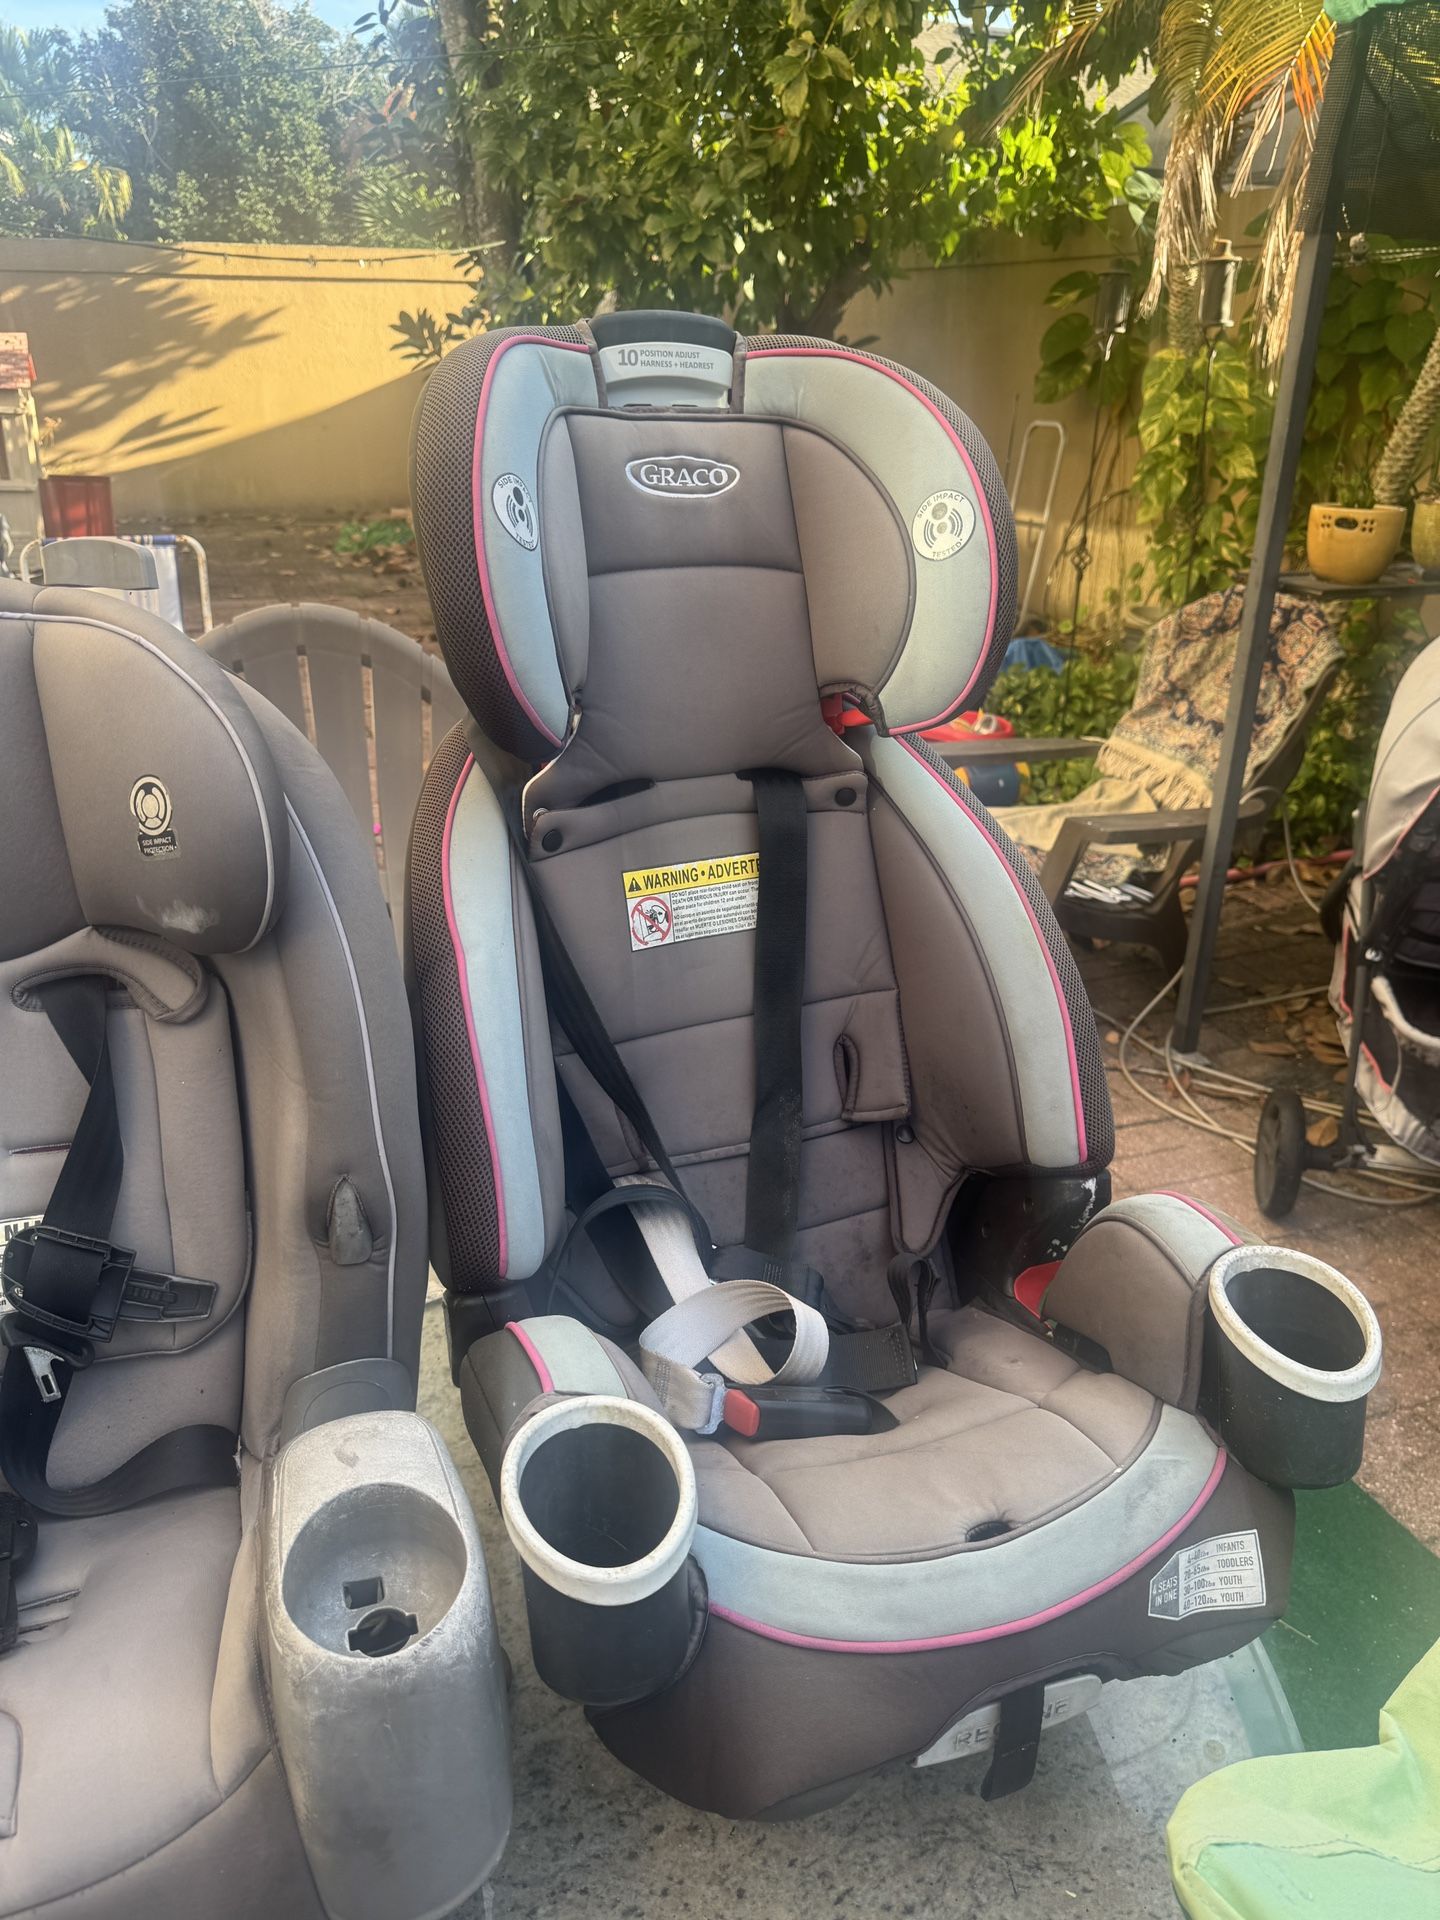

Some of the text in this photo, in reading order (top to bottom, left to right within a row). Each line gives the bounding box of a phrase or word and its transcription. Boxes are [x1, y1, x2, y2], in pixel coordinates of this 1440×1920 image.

[618, 349, 639, 366] 10
[640, 350, 700, 359] POSITION ADJUST
[640, 360, 672, 368] HARNESS
[680, 361, 714, 370] HEADREST
[640, 464, 728, 486] GRACO
[497, 476, 513, 489] SIDE
[917, 492, 965, 519] SIDE IMPACT
[153, 836, 172, 845] IMPACT
[643, 868, 699, 890] WARNING
[694, 893, 713, 901] SERIOUS
[717, 917, 737, 925] LESIONES
[1216, 1540, 1245, 1553] INFANTS
[1217, 1556, 1254, 1569] TODDLERS
[1158, 1576, 1178, 1593] SEATS
[1219, 1575, 1242, 1586] YOUTH
[1155, 1588, 1178, 1607] IN ONE
[1220, 1592, 1244, 1603] YOUTH
